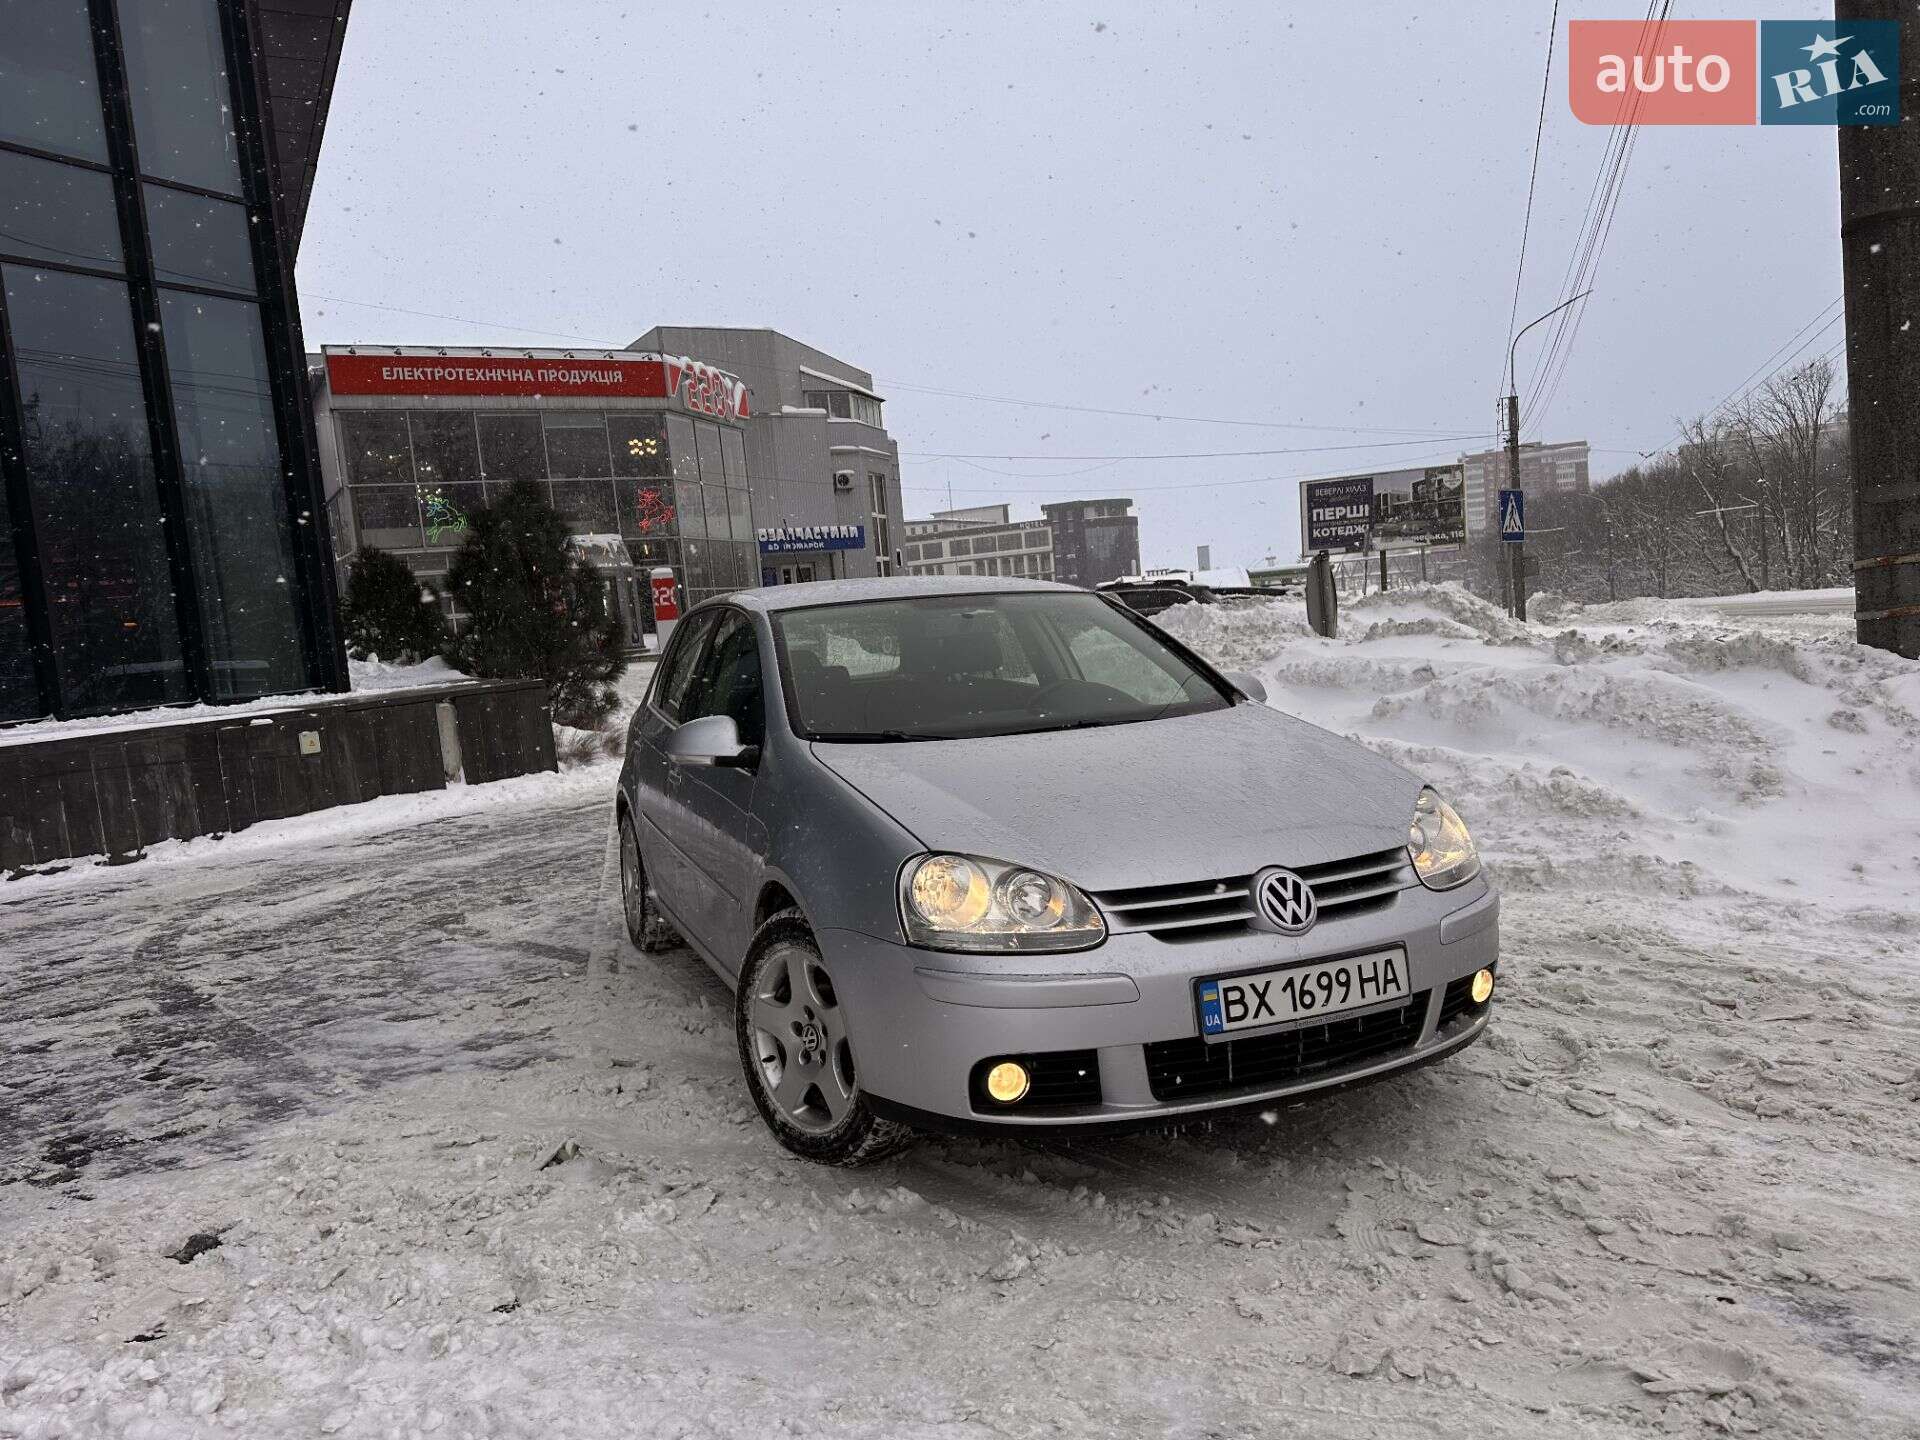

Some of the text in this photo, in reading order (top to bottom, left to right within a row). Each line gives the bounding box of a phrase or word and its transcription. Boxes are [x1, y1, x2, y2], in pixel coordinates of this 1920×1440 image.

[381, 366, 624, 385] ЕЛЕКТРОТЕХНІЧНА ПРОДУКЦІЯ
[1312, 504, 1370, 522] ПЕРШІ
[1223, 980, 1276, 1023] BX
[1281, 968, 1351, 1012] 1699
[1357, 958, 1402, 999] HA
[1205, 1015, 1221, 1027] UA
